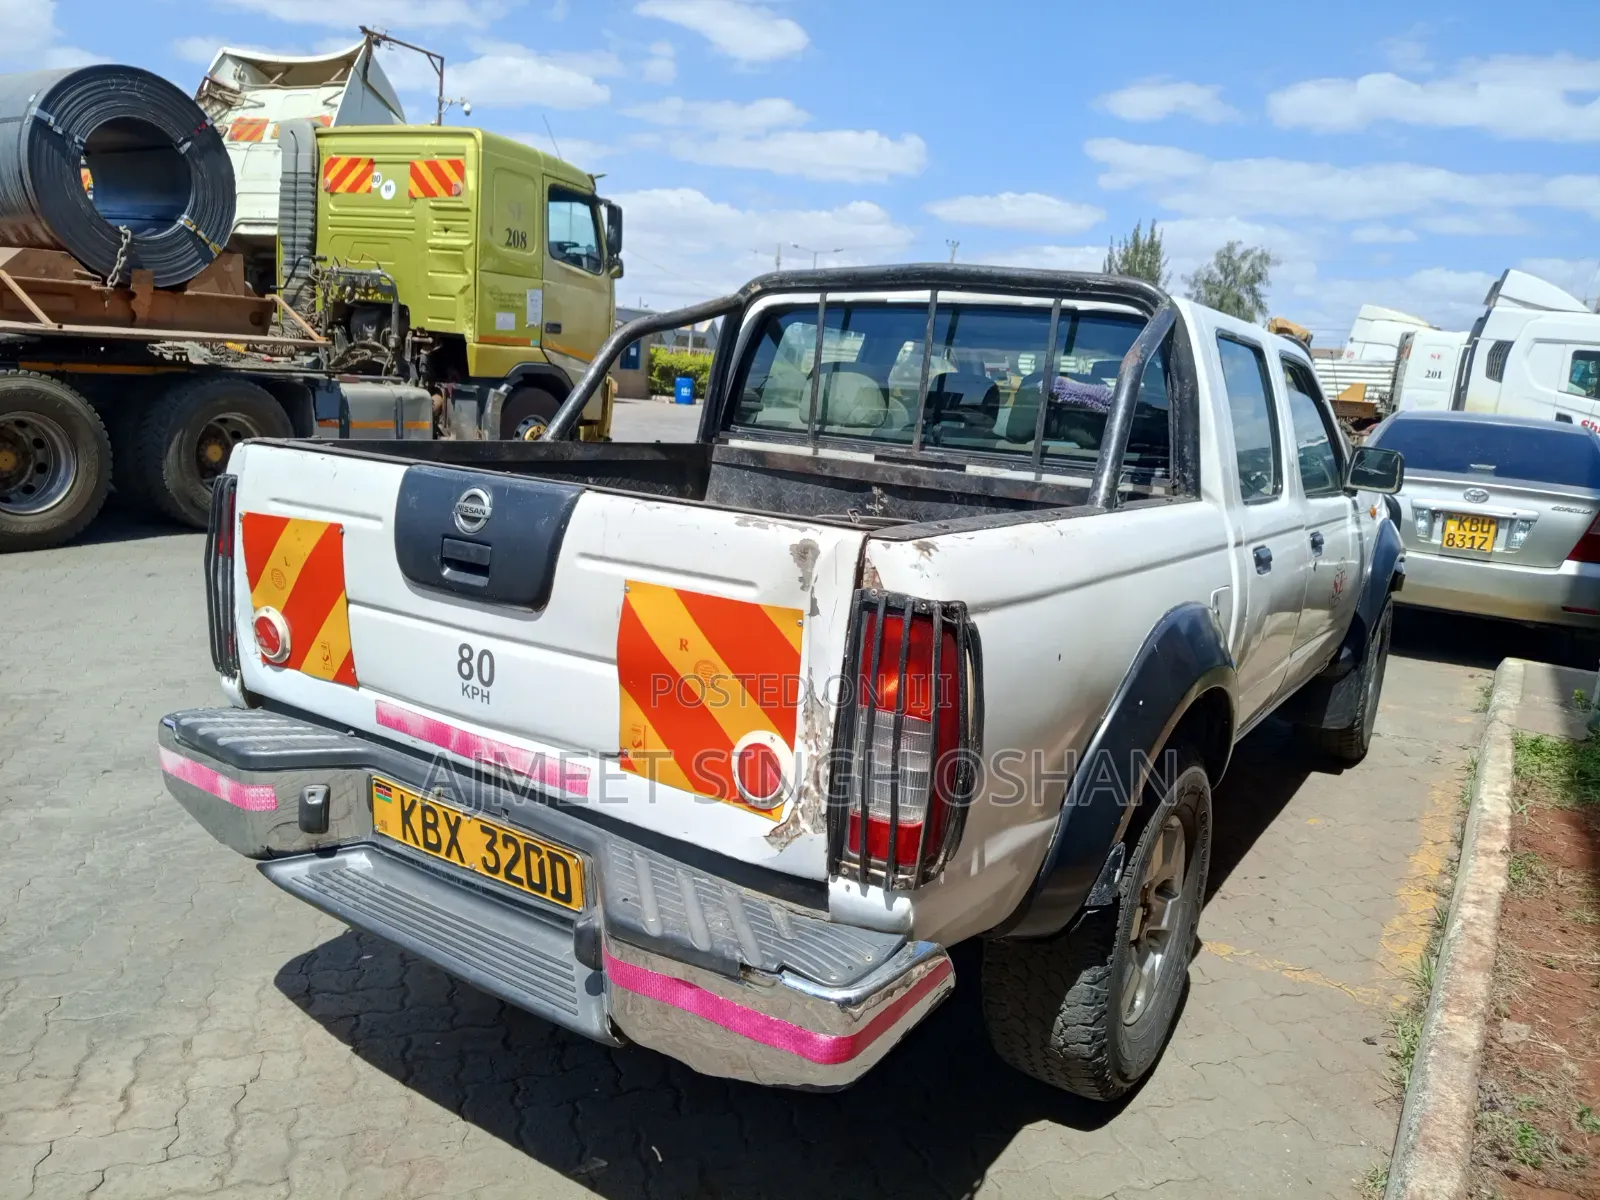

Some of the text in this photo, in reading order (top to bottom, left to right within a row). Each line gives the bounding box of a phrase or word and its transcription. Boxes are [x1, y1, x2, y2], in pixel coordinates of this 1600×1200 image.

[504, 227, 528, 250] 208
[1424, 369, 1443, 380] 201
[457, 504, 487, 516] NISSAN
[1551, 505, 1594, 516] COROLLA
[1457, 514, 1493, 534] KBU
[1445, 532, 1490, 551] 831Z
[679, 638, 689, 652] R
[457, 642, 496, 688] 80
[461, 681, 491, 705] KPH
[400, 794, 573, 905] KBX 320D
